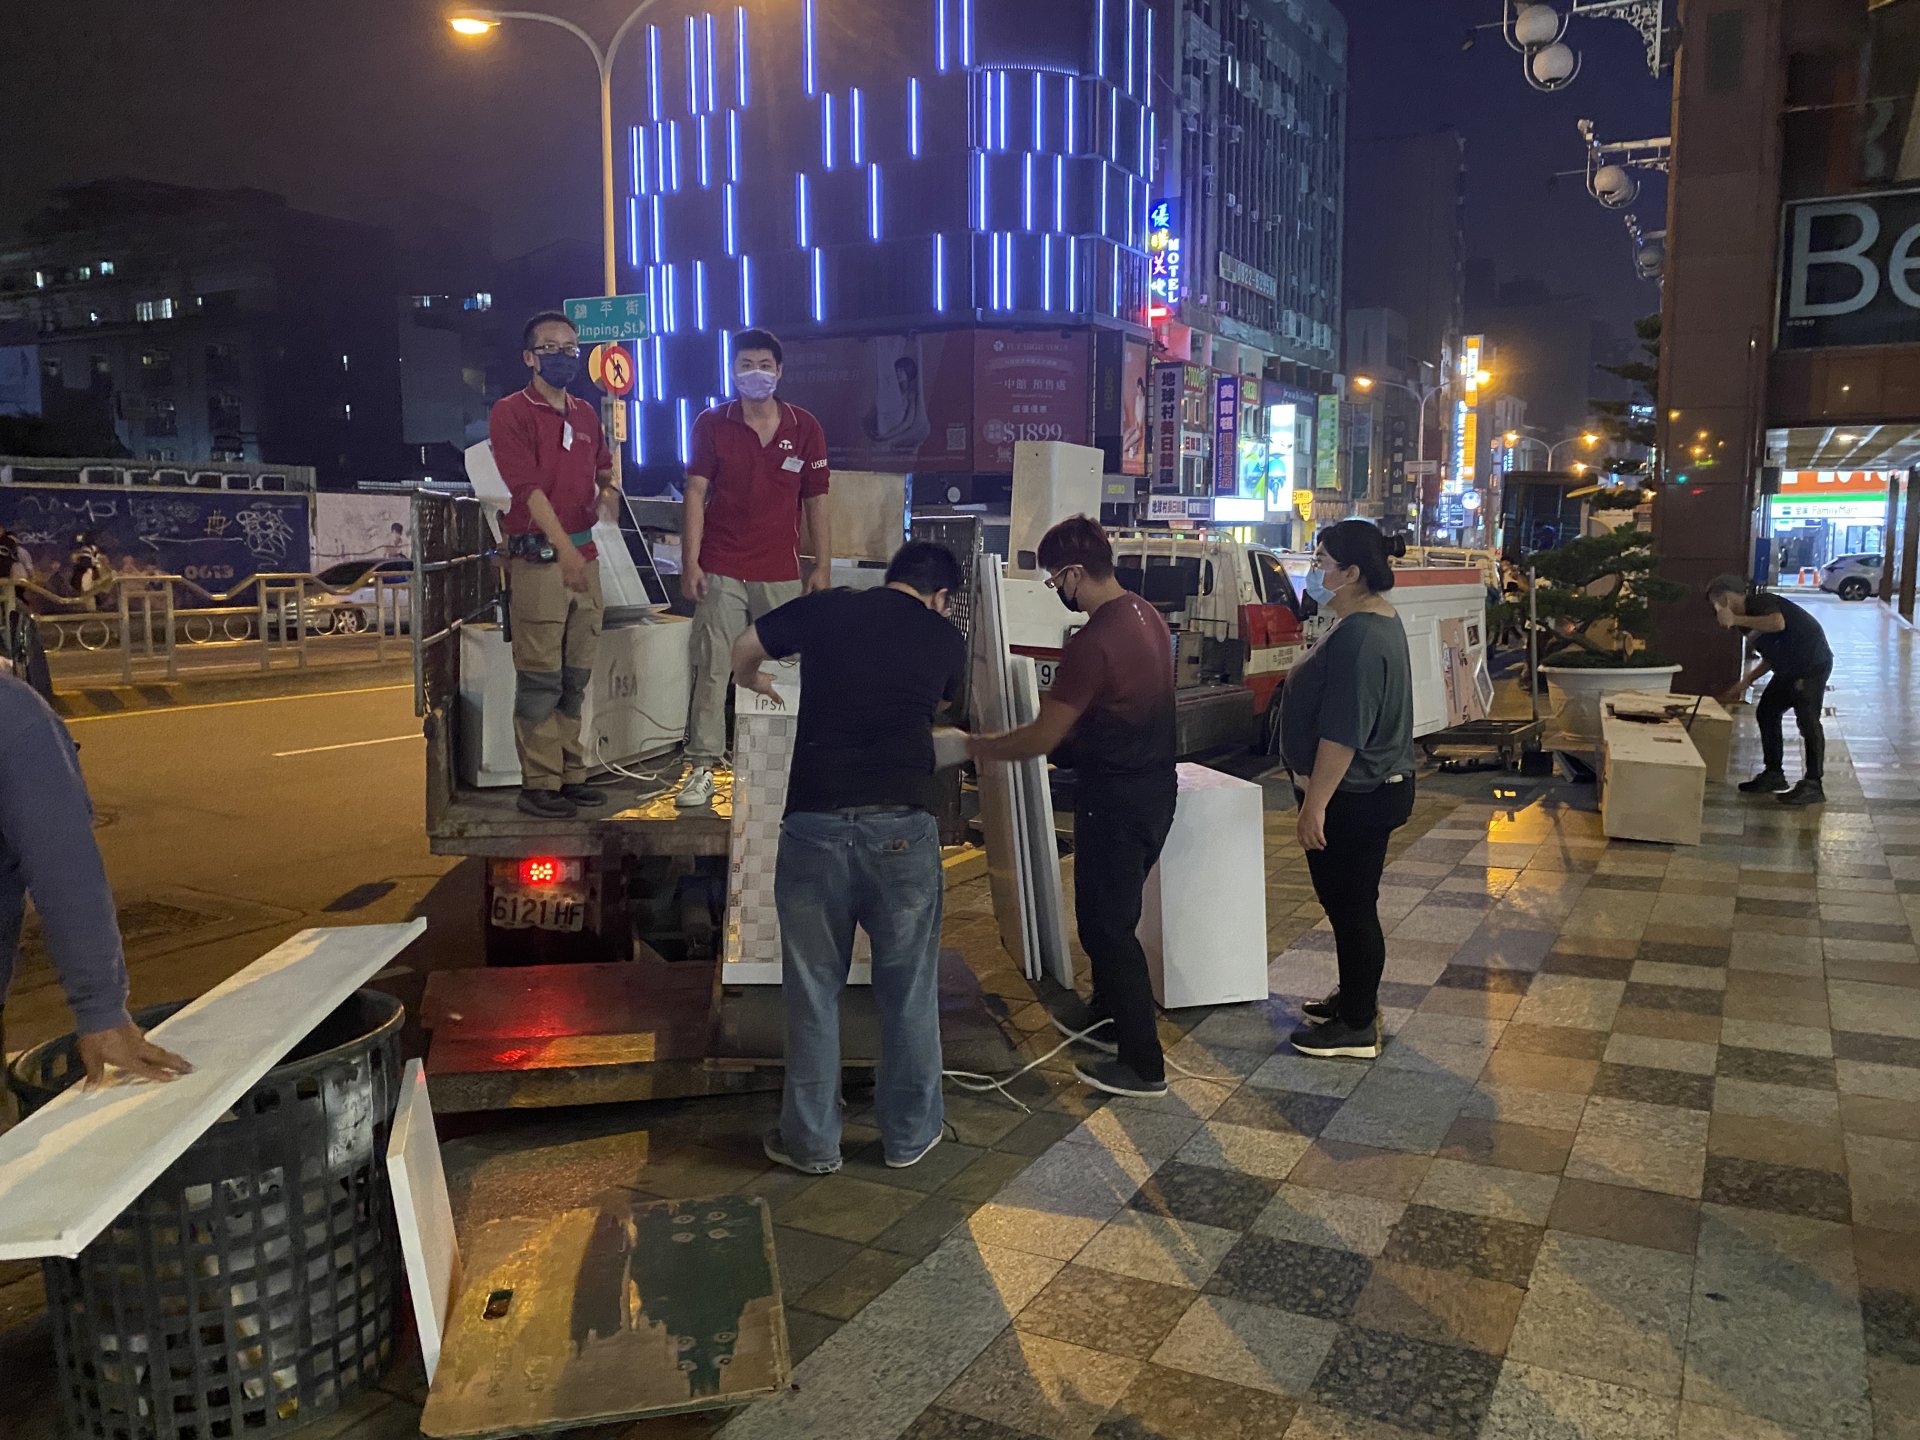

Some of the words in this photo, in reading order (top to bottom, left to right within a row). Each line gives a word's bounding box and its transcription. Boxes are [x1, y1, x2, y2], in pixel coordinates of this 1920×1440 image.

[1168, 238, 1180, 303] MOTEL
[574, 299, 639, 319] 錦平街
[577, 323, 620, 338] Jinping
[1003, 420, 1062, 442] $1899
